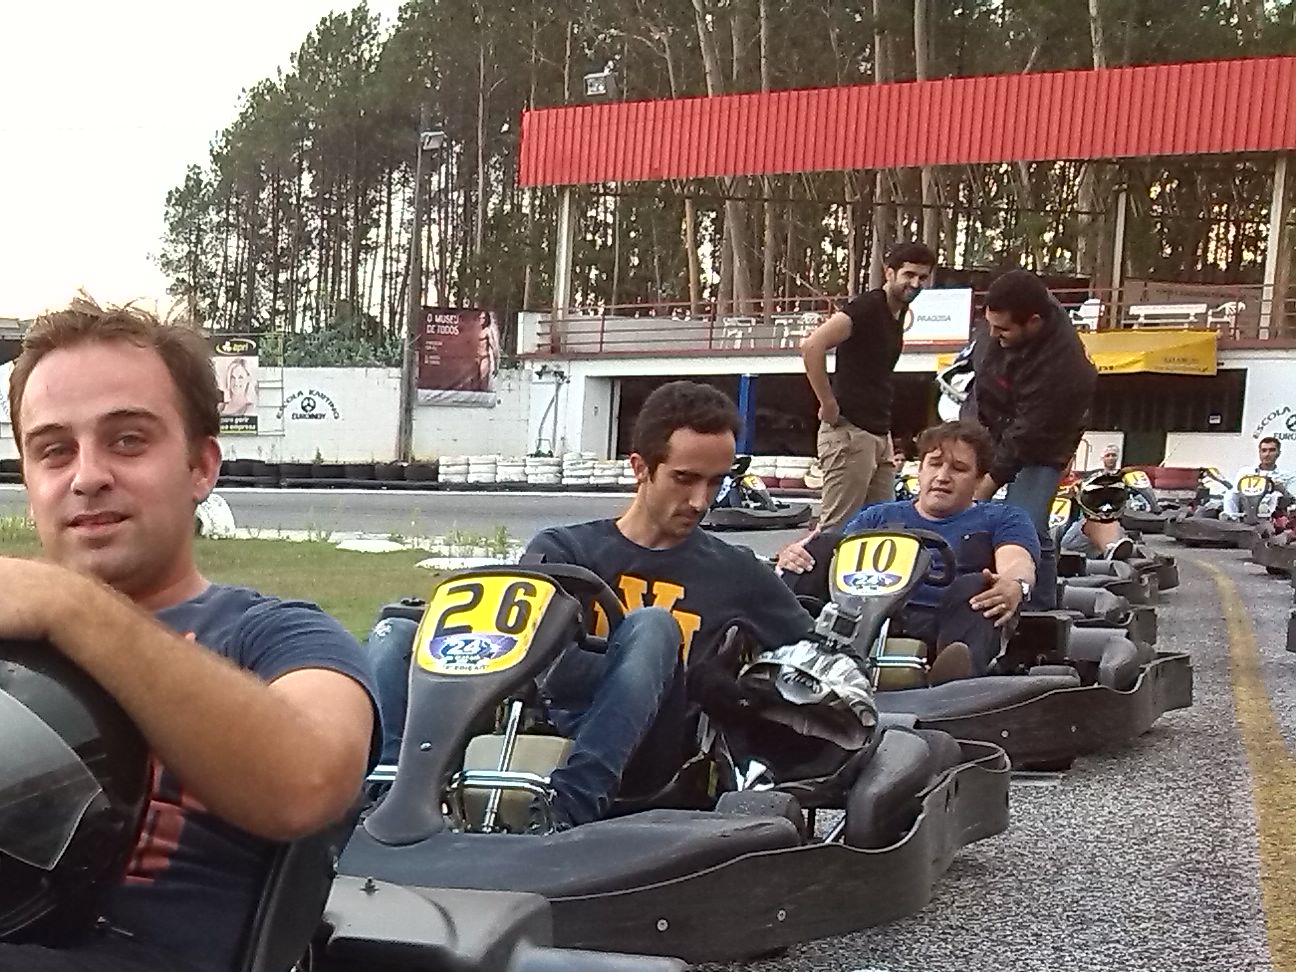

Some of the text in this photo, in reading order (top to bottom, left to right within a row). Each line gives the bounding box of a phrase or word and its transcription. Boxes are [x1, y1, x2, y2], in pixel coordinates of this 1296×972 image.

[1246, 477, 1262, 489] 17
[855, 538, 897, 573] 10
[434, 581, 537, 637] 26
